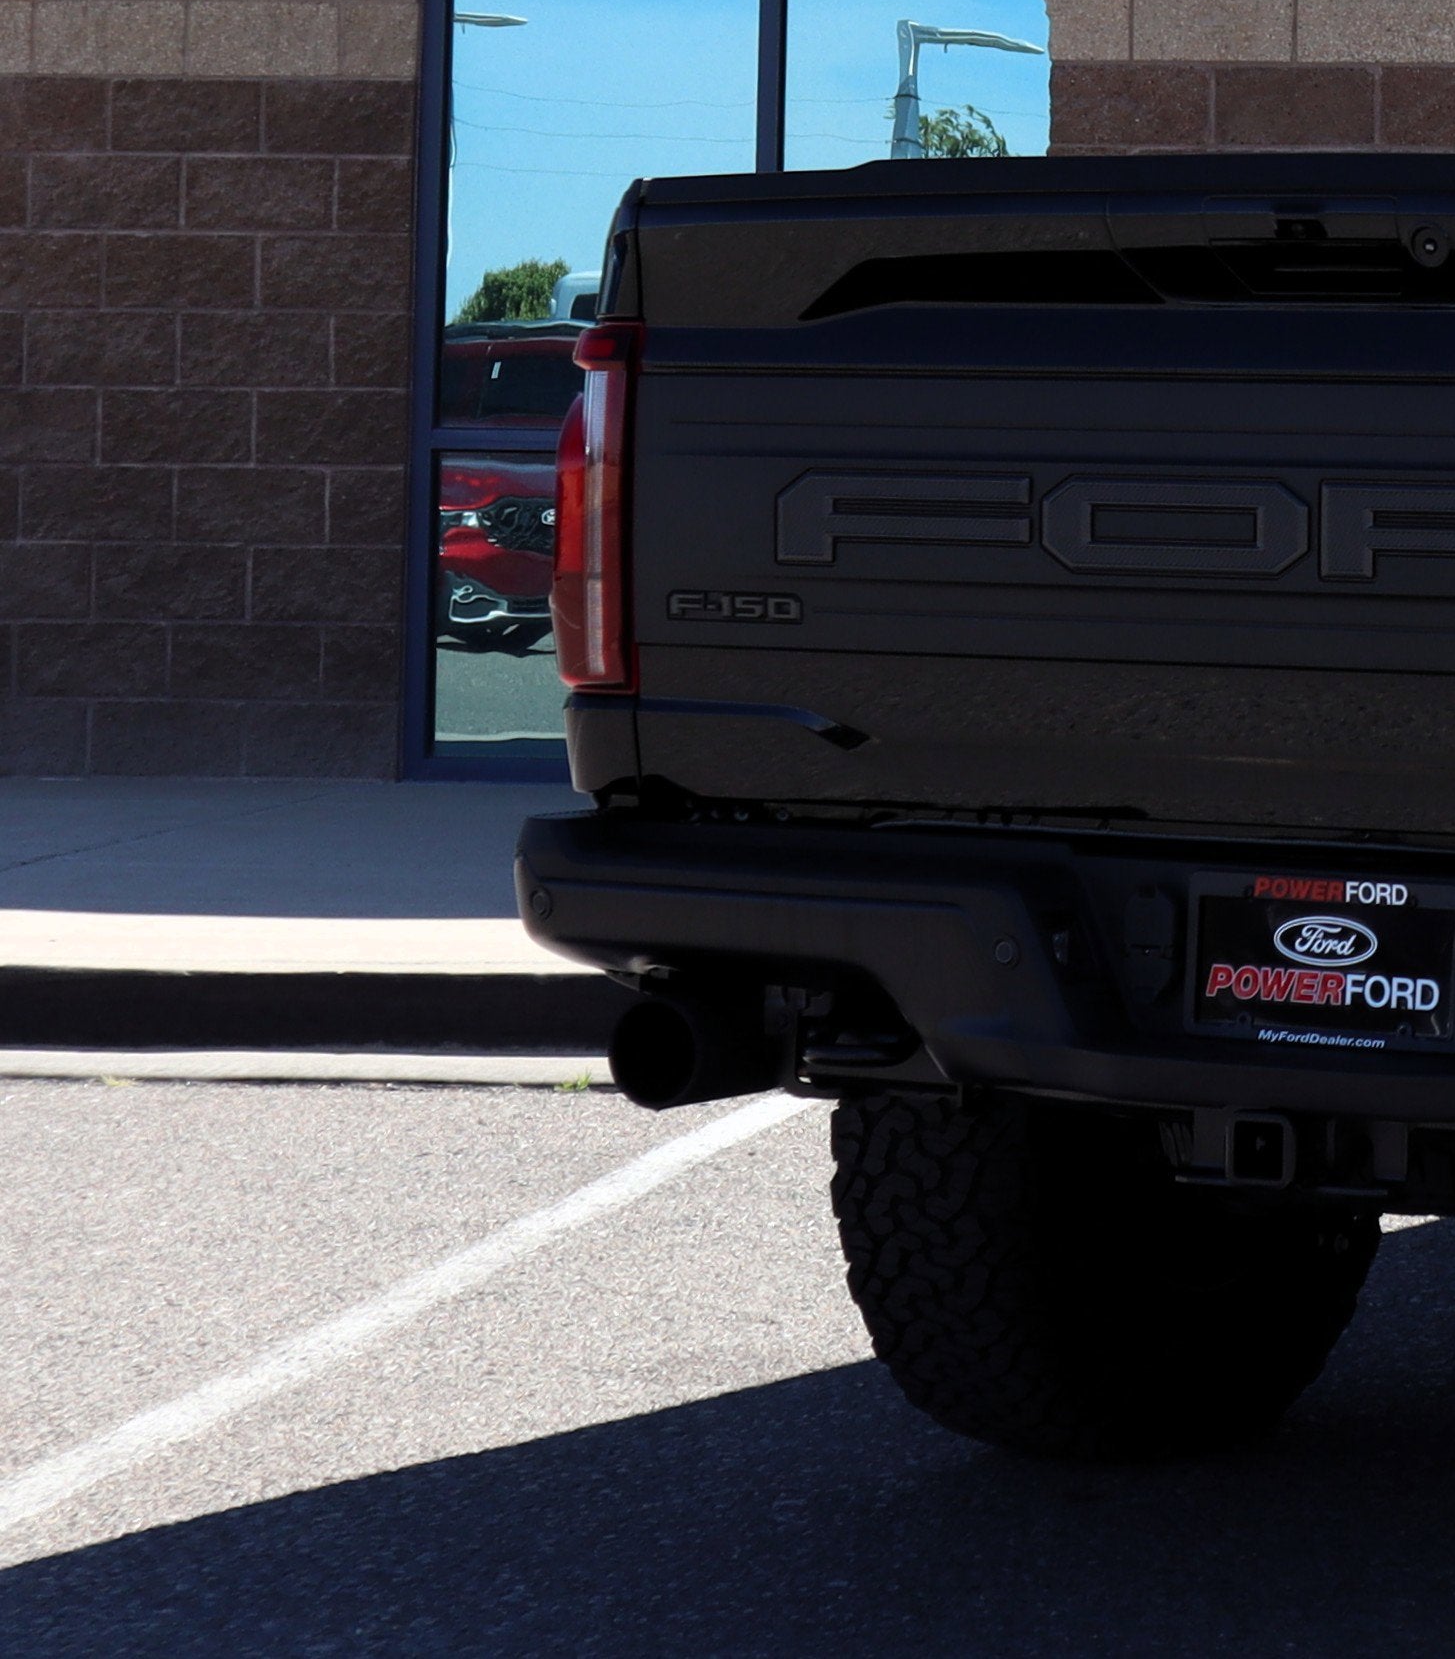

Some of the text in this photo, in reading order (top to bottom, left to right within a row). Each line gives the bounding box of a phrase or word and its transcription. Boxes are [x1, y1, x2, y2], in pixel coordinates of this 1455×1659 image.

[669, 591, 800, 622] F-150
[1294, 923, 1358, 956] Ford
[1257, 1028, 1386, 1049] MyFordDealer.com
